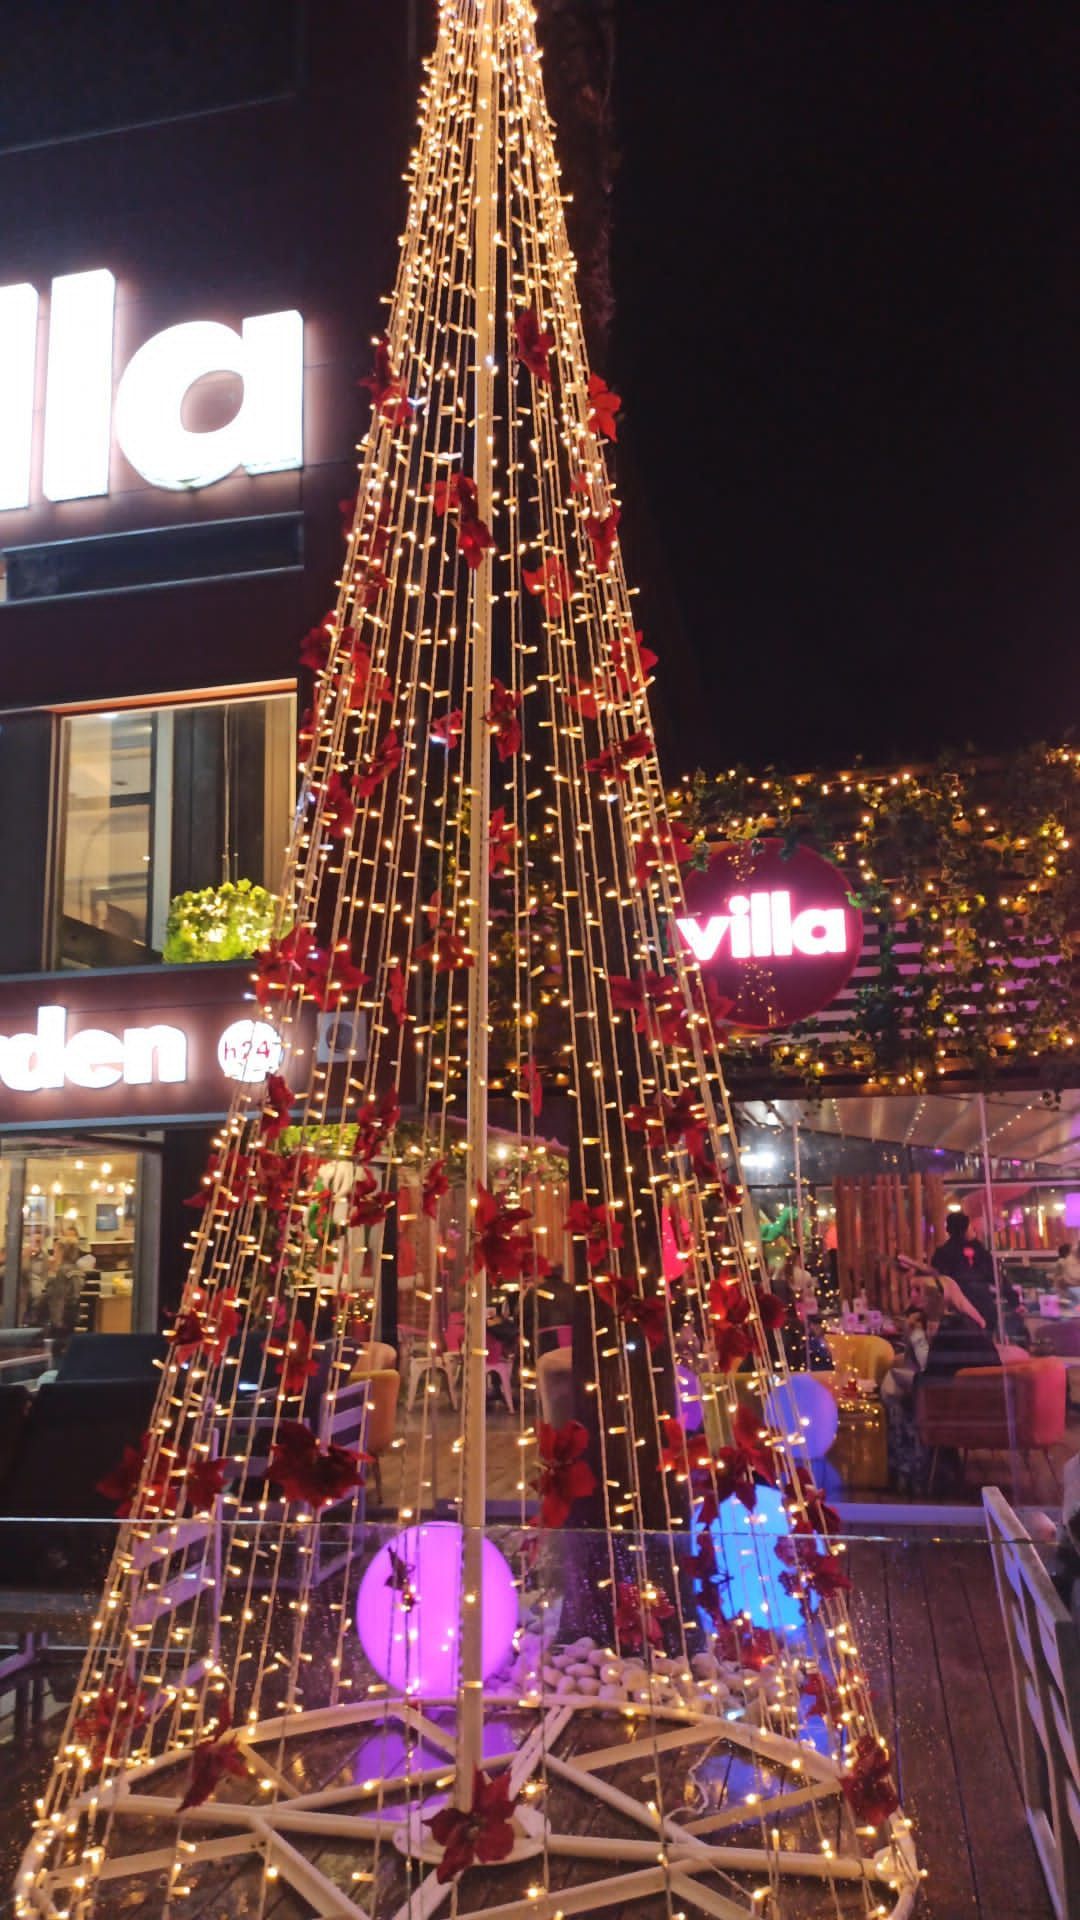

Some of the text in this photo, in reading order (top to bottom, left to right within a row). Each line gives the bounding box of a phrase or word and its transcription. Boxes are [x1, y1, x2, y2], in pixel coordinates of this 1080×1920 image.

[676, 891, 847, 960] villa
[0, 1005, 270, 1091] den h24
